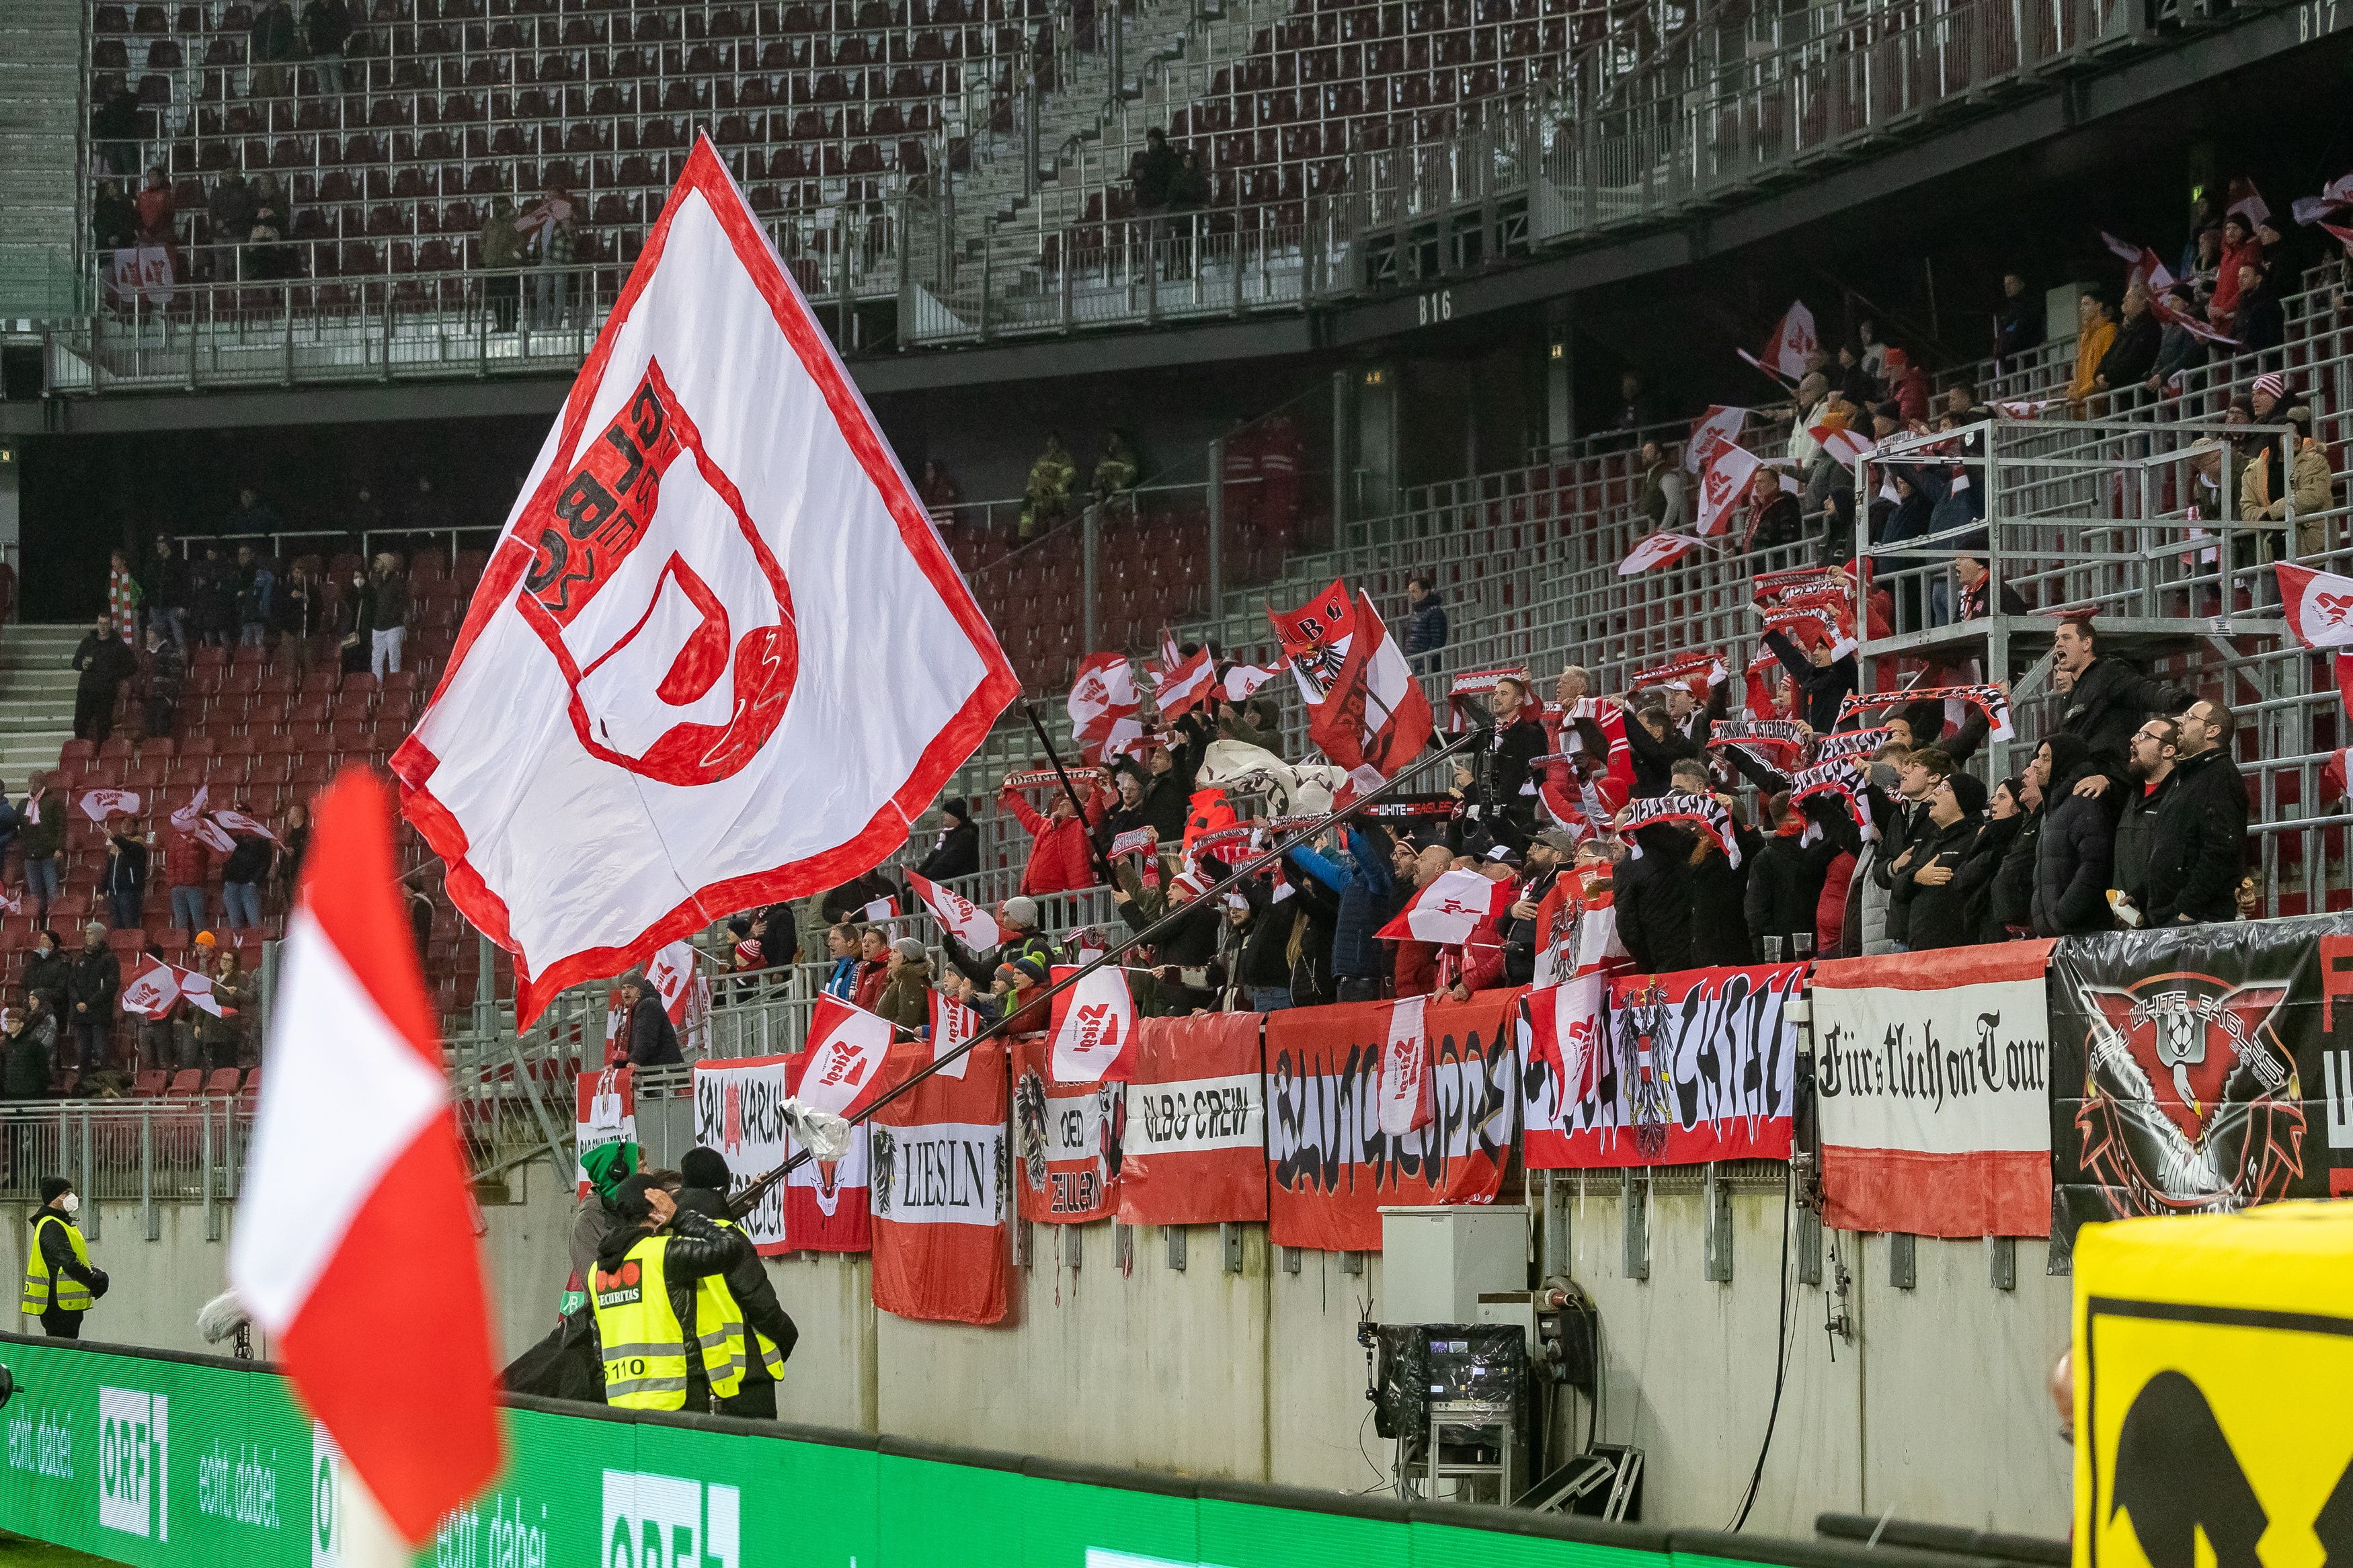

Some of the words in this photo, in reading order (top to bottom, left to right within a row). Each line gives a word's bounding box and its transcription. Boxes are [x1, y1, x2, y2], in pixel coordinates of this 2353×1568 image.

[2299, 0, 2336, 44] B17
[1419, 290, 1451, 326] B16
[1379, 804, 1406, 816] WHITE
[1414, 802, 1453, 815] EAGLES
[1819, 1018, 1944, 1114] Fürstlich
[1946, 1045, 1977, 1100] on
[1977, 1009, 2045, 1093] Tour
[2089, 1023, 2130, 1085] RED
[2128, 991, 2188, 1032] WHITE
[2195, 993, 2285, 1086] EAGLES
[696, 1075, 723, 1145] SAU
[1060, 1109, 1084, 1148] OED
[1144, 1092, 1191, 1143] GLBG
[1193, 1086, 1248, 1139] CREW
[903, 1141, 985, 1208] LIESLN
[8, 1403, 35, 1472] echt.
[38, 1407, 75, 1480] dabei.
[199, 1438, 231, 1518] echt.
[235, 1442, 280, 1529] dabei.
